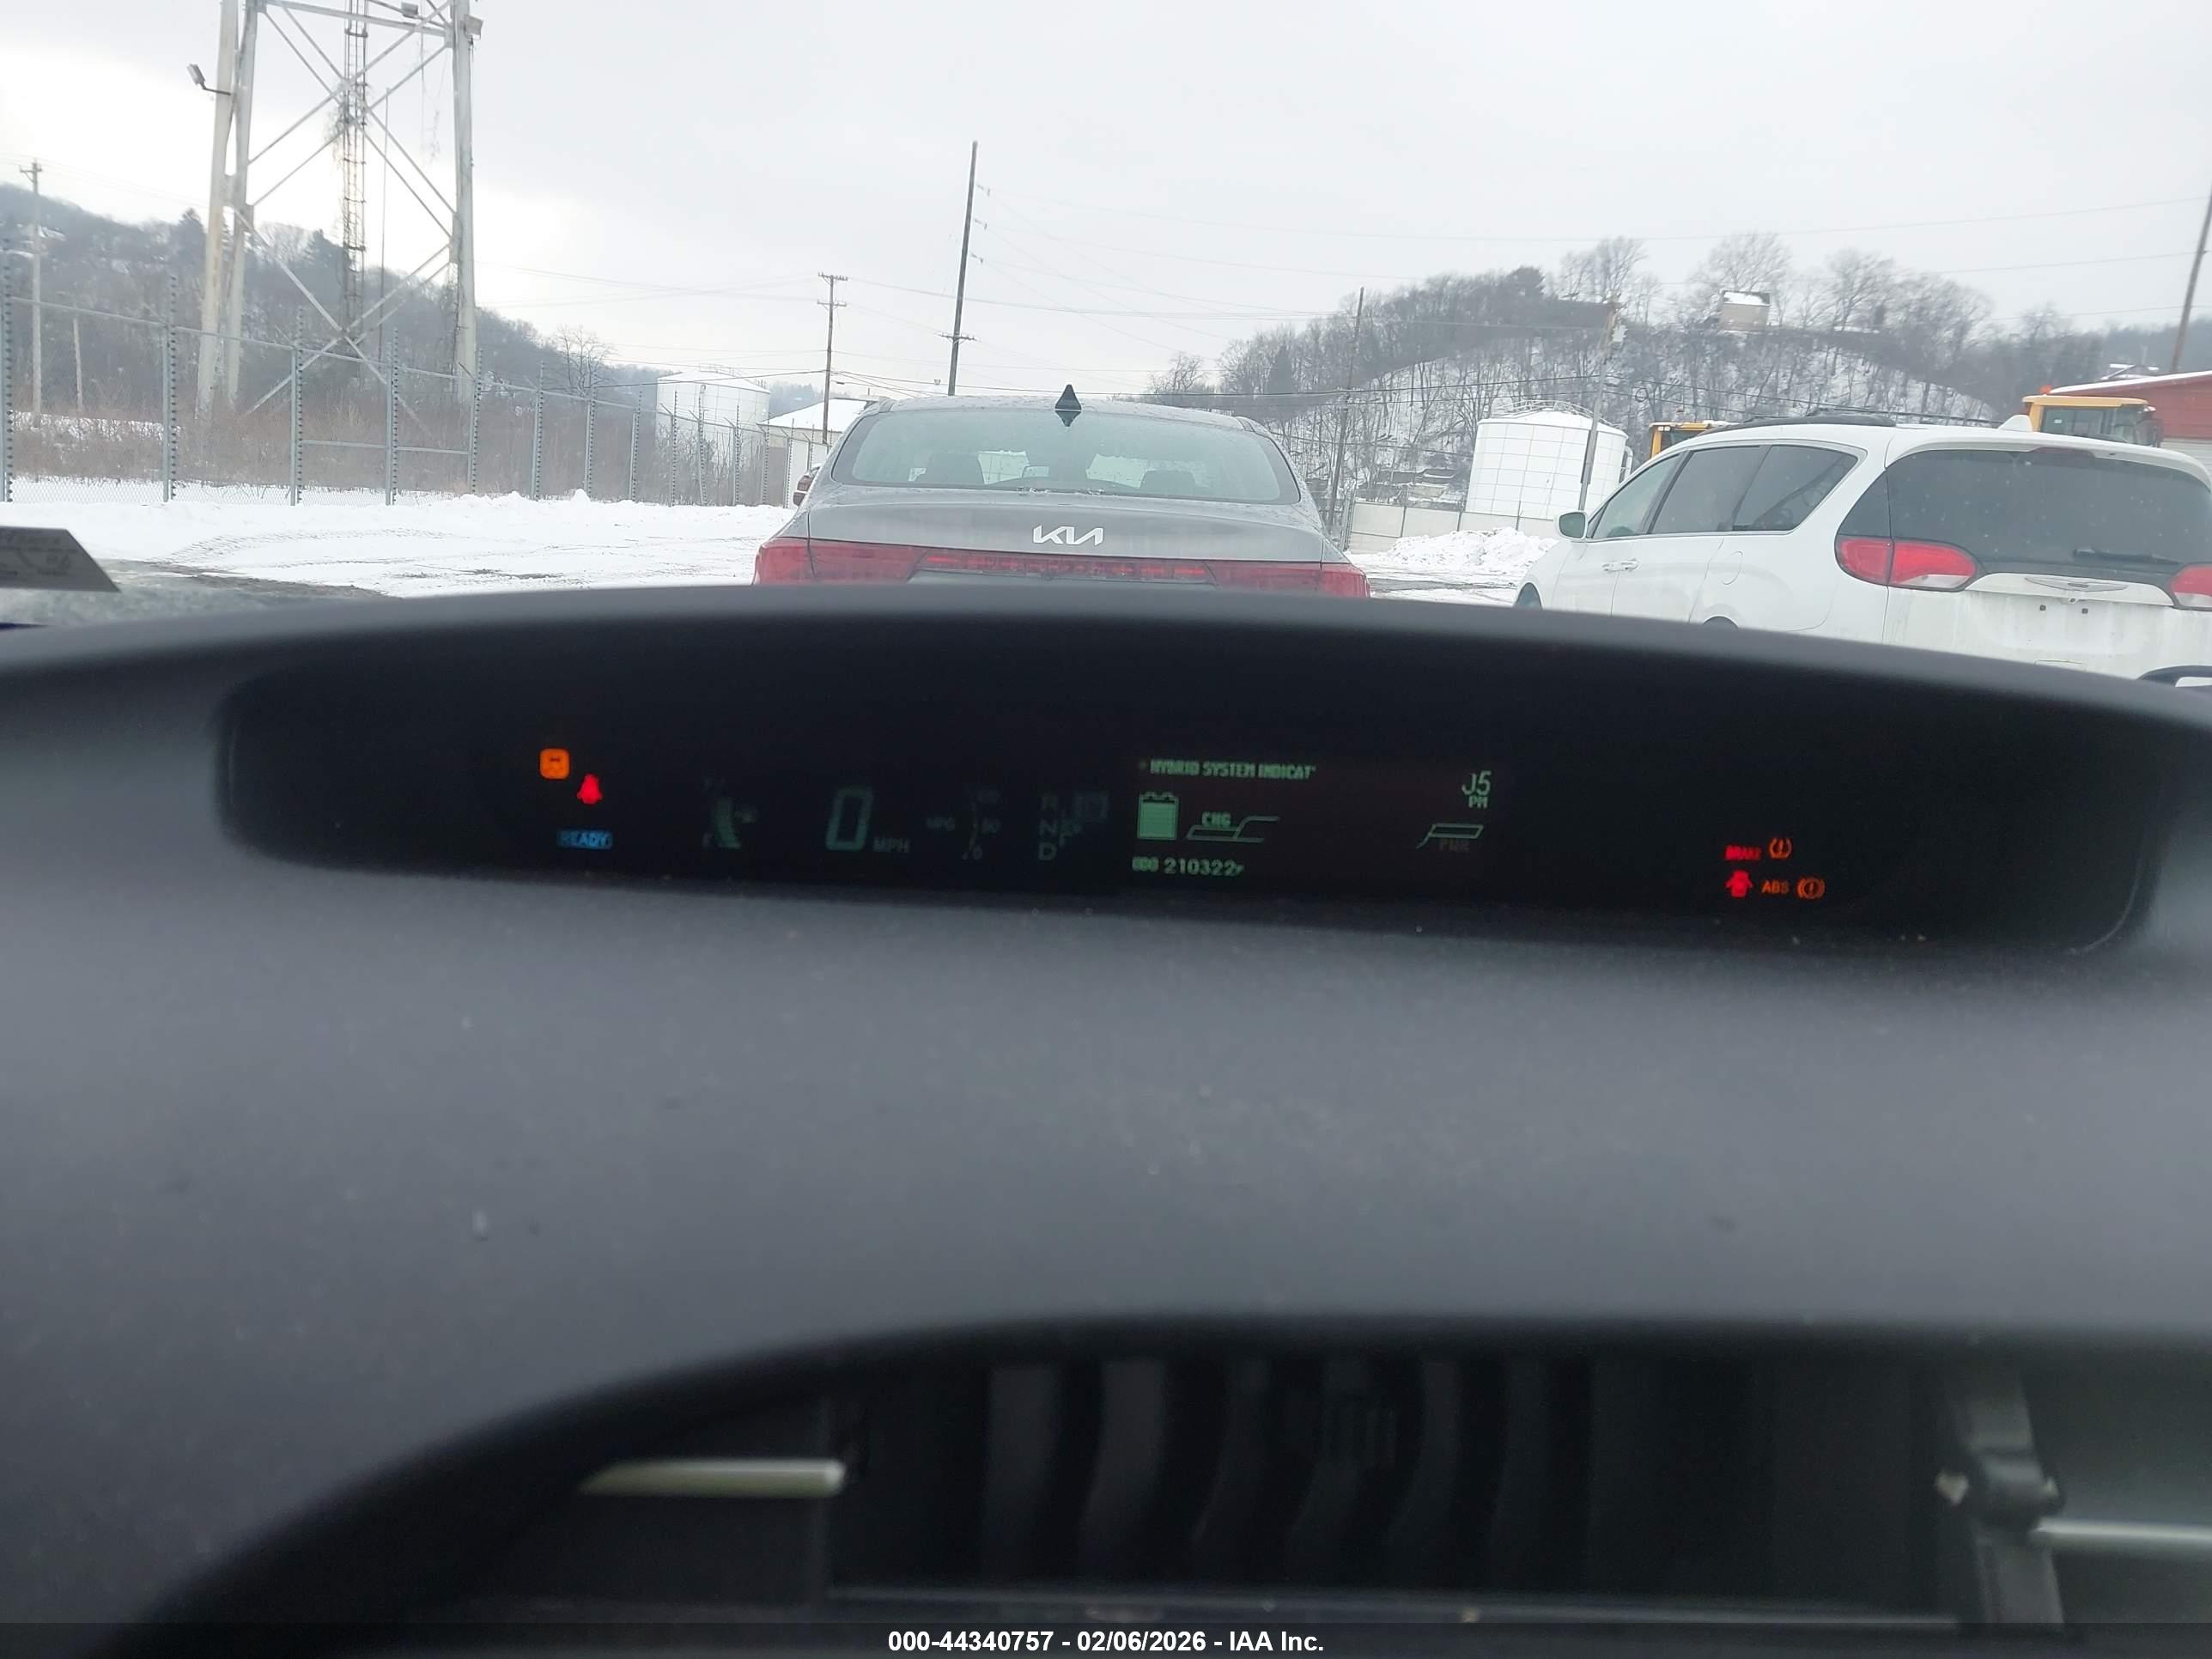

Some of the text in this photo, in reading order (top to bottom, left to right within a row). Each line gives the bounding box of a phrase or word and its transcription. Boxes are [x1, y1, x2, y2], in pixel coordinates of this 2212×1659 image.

[1033, 525, 1103, 545] KIA
[1150, 760, 1200, 776] HYBRID
[1201, 762, 1255, 778] SYSTEM
[1761, 878, 1790, 894] ABS
